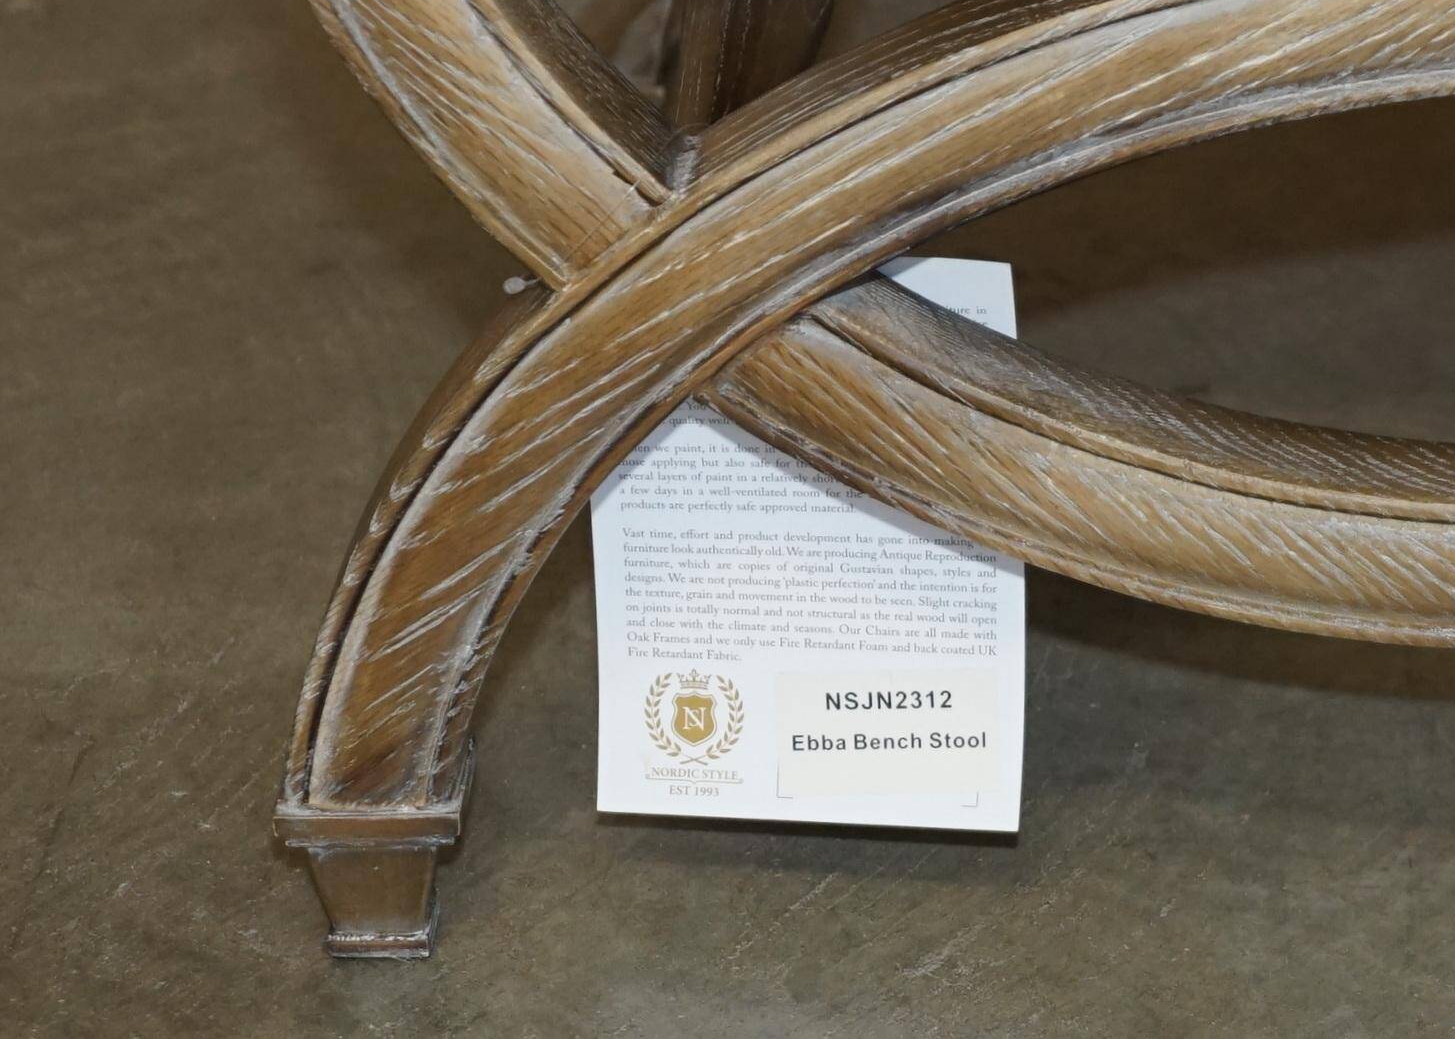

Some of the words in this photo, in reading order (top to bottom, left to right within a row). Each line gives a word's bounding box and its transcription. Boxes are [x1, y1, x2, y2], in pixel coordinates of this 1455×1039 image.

[669, 415, 704, 428] quality
[674, 443, 704, 454] paint,
[709, 444, 716, 452] it
[721, 444, 730, 452] is
[734, 443, 760, 454] done
[765, 444, 775, 453] in
[651, 457, 696, 469] applying
[701, 458, 719, 467] but
[725, 457, 745, 467] also
[750, 457, 770, 467] safe
[775, 458, 790, 468] for
[618, 472, 653, 481] several
[658, 472, 687, 483] layers
[691, 472, 703, 482] of
[705, 473, 732, 484] paint
[737, 473, 747, 482] in
[761, 473, 807, 486] relatively
[630, 486, 649, 495] few
[654, 486, 677, 497] days
[683, 487, 693, 495] in
[709, 487, 787, 497] well-ventilated
[825, 489, 841, 498] for
[620, 499, 665, 510] products
[669, 502, 684, 510] are
[688, 501, 734, 512] perfectly
[736, 501, 757, 511] safe
[760, 501, 807, 514] approved
[622, 527, 645, 539] Vast
[649, 528, 677, 540] time,
[680, 529, 709, 540] effort
[713, 529, 733, 540] and
[738, 530, 778, 544] product
[783, 531, 851, 544] development
[856, 533, 873, 544] has
[878, 536, 903, 547] gone
[908, 535, 930, 545] into
[623, 542, 669, 553] furniture
[671, 544, 694, 554] look
[696, 544, 763, 557] authentically
[764, 545, 785, 556] old.
[786, 546, 804, 557] We
[806, 549, 822, 558] are
[824, 547, 877, 561] producing
[879, 549, 922, 561] Antique
[925, 550, 997, 563] Reproduction
[624, 557, 673, 569] furniture,
[678, 559, 710, 570] which
[738, 562, 771, 572] copies
[776, 561, 787, 572] of
[793, 563, 834, 574] original
[840, 563, 894, 575] Gustavian
[900, 565, 937, 579] shapes,
[942, 566, 971, 579] styles
[977, 568, 997, 579] and
[624, 572, 665, 584] designs.
[668, 572, 686, 584] We
[707, 576, 725, 585] not
[728, 576, 781, 588] producing
[878, 580, 897, 590] and
[900, 582, 917, 592] the
[919, 583, 968, 593] intention
[971, 583, 979, 593] is
[982, 583, 997, 593] for
[625, 587, 642, 597] the
[645, 588, 684, 599] texture,
[686, 590, 712, 601] grain
[715, 590, 735, 600] and
[738, 591, 793, 602] movement
[796, 593, 809, 602] in
[810, 592, 827, 603] the
[830, 594, 858, 604] wood
[861, 597, 872, 605] to
[875, 595, 887, 605] be
[890, 598, 916, 606] seen.
[918, 596, 950, 609] Slight
[952, 597, 997, 611] cracking
[625, 604, 639, 612] on
[642, 603, 671, 615] joints
[675, 604, 683, 613] is
[687, 604, 720, 616] totally
[723, 606, 760, 616] normal
[763, 607, 783, 617] and
[786, 608, 804, 618] not
[807, 609, 857, 620] structural
[874, 610, 890, 621] the
[894, 611, 913, 622] real
[916, 612, 945, 623] wood
[948, 613, 968, 624] will
[971, 616, 997, 626] open
[626, 616, 645, 627] and
[650, 617, 675, 628] close
[679, 618, 703, 629] with
[708, 619, 724, 630] the
[728, 620, 766, 632] climate
[770, 622, 790, 632] and
[794, 624, 835, 634] seasons.
[839, 623, 862, 635] Our
[865, 624, 900, 637] Chairs
[904, 629, 920, 638] are
[925, 627, 937, 638] all
[941, 629, 969, 640] made
[973, 630, 997, 641] with
[626, 631, 650, 643] Oak
[652, 632, 691, 644] Frames
[693, 634, 713, 645] and
[715, 637, 730, 646] we
[733, 636, 756, 648] only
[759, 639, 776, 647] use
[779, 637, 800, 649] Fire
[804, 638, 856, 651] Retardant
[859, 640, 888, 651] Foam
[891, 642, 911, 653] and
[913, 641, 941, 654] back
[940, 644, 975, 656] coated
[978, 644, 997, 656] UK
[628, 646, 648, 658] Fire
[652, 647, 703, 660] Retardant
[706, 649, 742, 662] Fabric.
[825, 690, 952, 710] NSJN2312
[792, 735, 846, 751] Ebba
[854, 733, 922, 750] Bench
[929, 731, 986, 748] Stool
[651, 767, 700, 779] NORDIC
[702, 769, 738, 780] STYLE
[669, 785, 691, 795] EST
[695, 786, 719, 797] 1993
